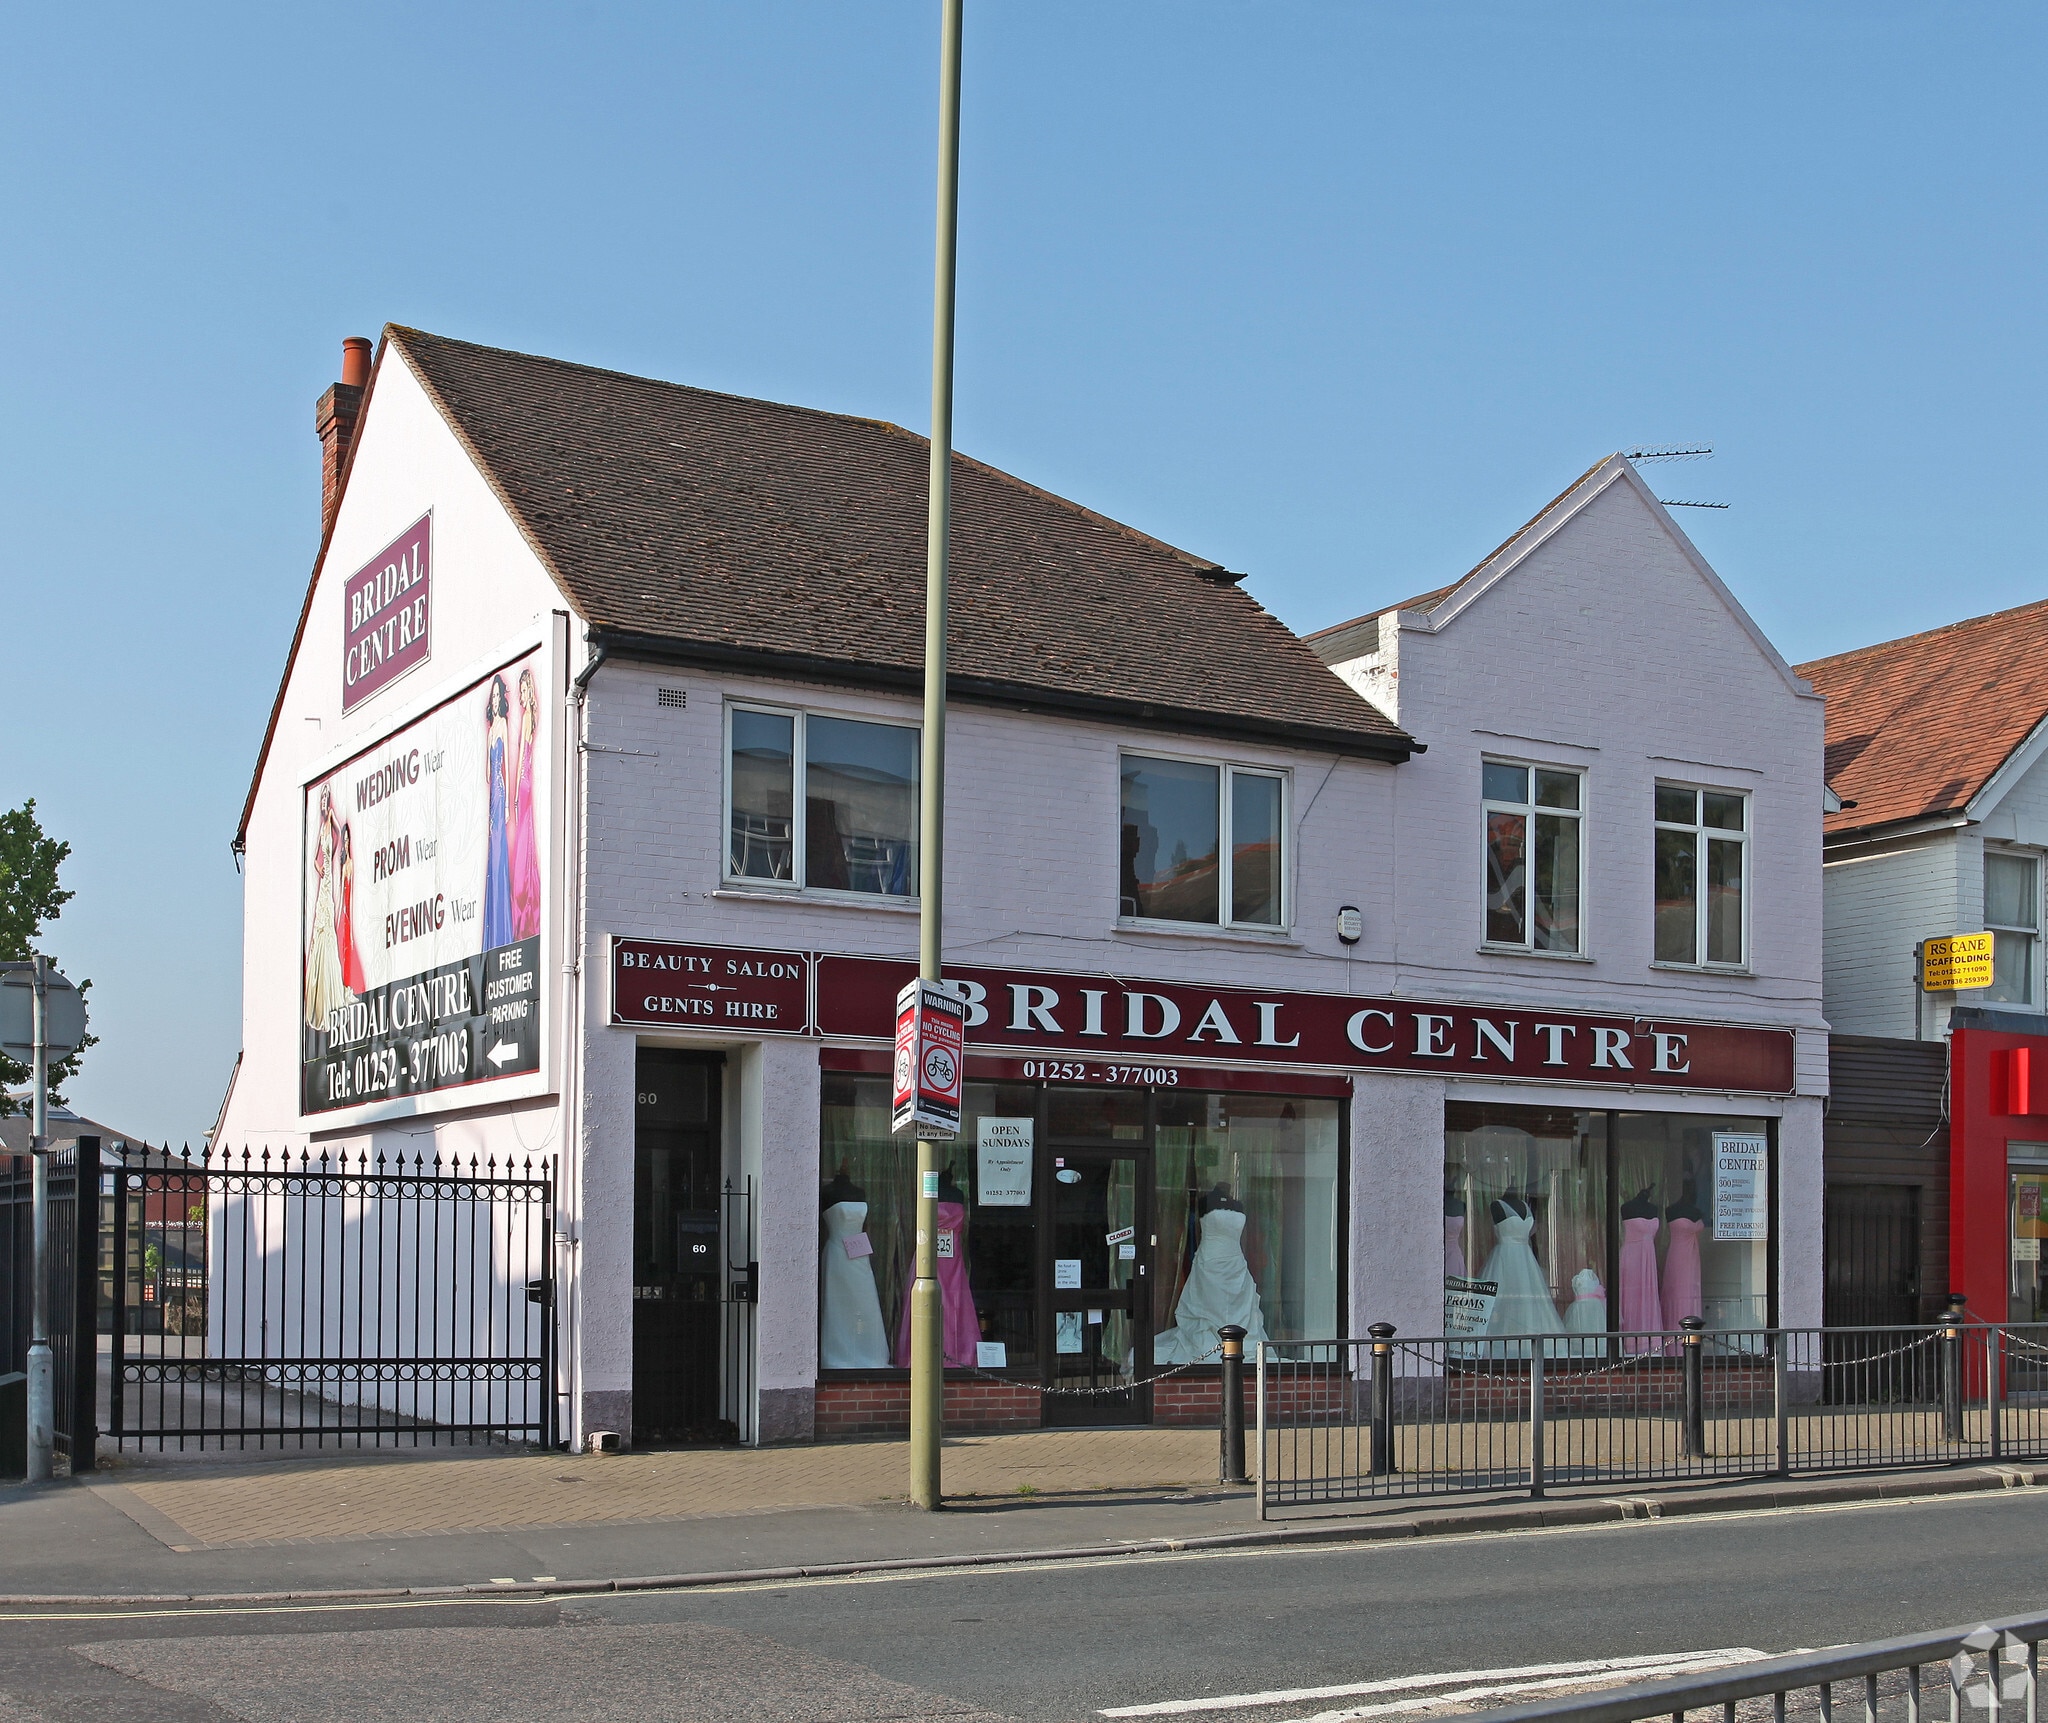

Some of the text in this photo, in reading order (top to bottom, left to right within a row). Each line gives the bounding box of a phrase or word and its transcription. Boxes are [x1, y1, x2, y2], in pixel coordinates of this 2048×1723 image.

[351, 541, 424, 633] BRIDAL
[346, 594, 426, 687] CENTRE
[356, 748, 445, 812] WEDDING Wear
[374, 834, 438, 884] PROM Wear
[386, 893, 477, 950] EVENING Wear
[1930, 939, 1986, 956] RS CANE
[499, 948, 522, 972] FREE
[621, 951, 800, 980] BEAUTY SALON
[1926, 953, 1990, 967] SCAFFOLDING
[1941, 968, 1961, 976] 01252
[1962, 966, 1987, 974] 711090
[487, 971, 533, 1001] CUSTOMER
[328, 968, 472, 1049] BRIDAL CENTRE
[491, 999, 528, 1025] PARKING
[643, 995, 779, 1020] GENTS HIRE
[924, 993, 962, 1016] WARNING
[931, 1017, 940, 1025] This
[940, 978, 1691, 1074] BRIDAL CENTRE
[922, 1021, 933, 1032] NO
[933, 1025, 961, 1041] CYCLING
[326, 1060, 351, 1101] Tel:
[354, 1047, 397, 1095] 01252
[410, 1028, 469, 1084] 377003
[1023, 1060, 1087, 1081] 01252
[1105, 1065, 1179, 1086] 377003
[638, 1092, 658, 1105] 60
[991, 1125, 1020, 1135] OPEN
[982, 1138, 1030, 1148] SUNDAYS
[1721, 1141, 1762, 1154] BRIDAL
[1719, 1158, 1765, 1170] CENTRE
[1718, 1179, 1732, 1188] 300
[1718, 1193, 1732, 1202] 250
[1718, 1208, 1732, 1217] 250
[1109, 1229, 1132, 1241] CLOSED
[692, 1244, 707, 1253] 60
[1471, 1283, 1497, 1293] CENTRE
[1446, 1295, 1485, 1310] PROMS
[1455, 1312, 1489, 1326] Thursday
